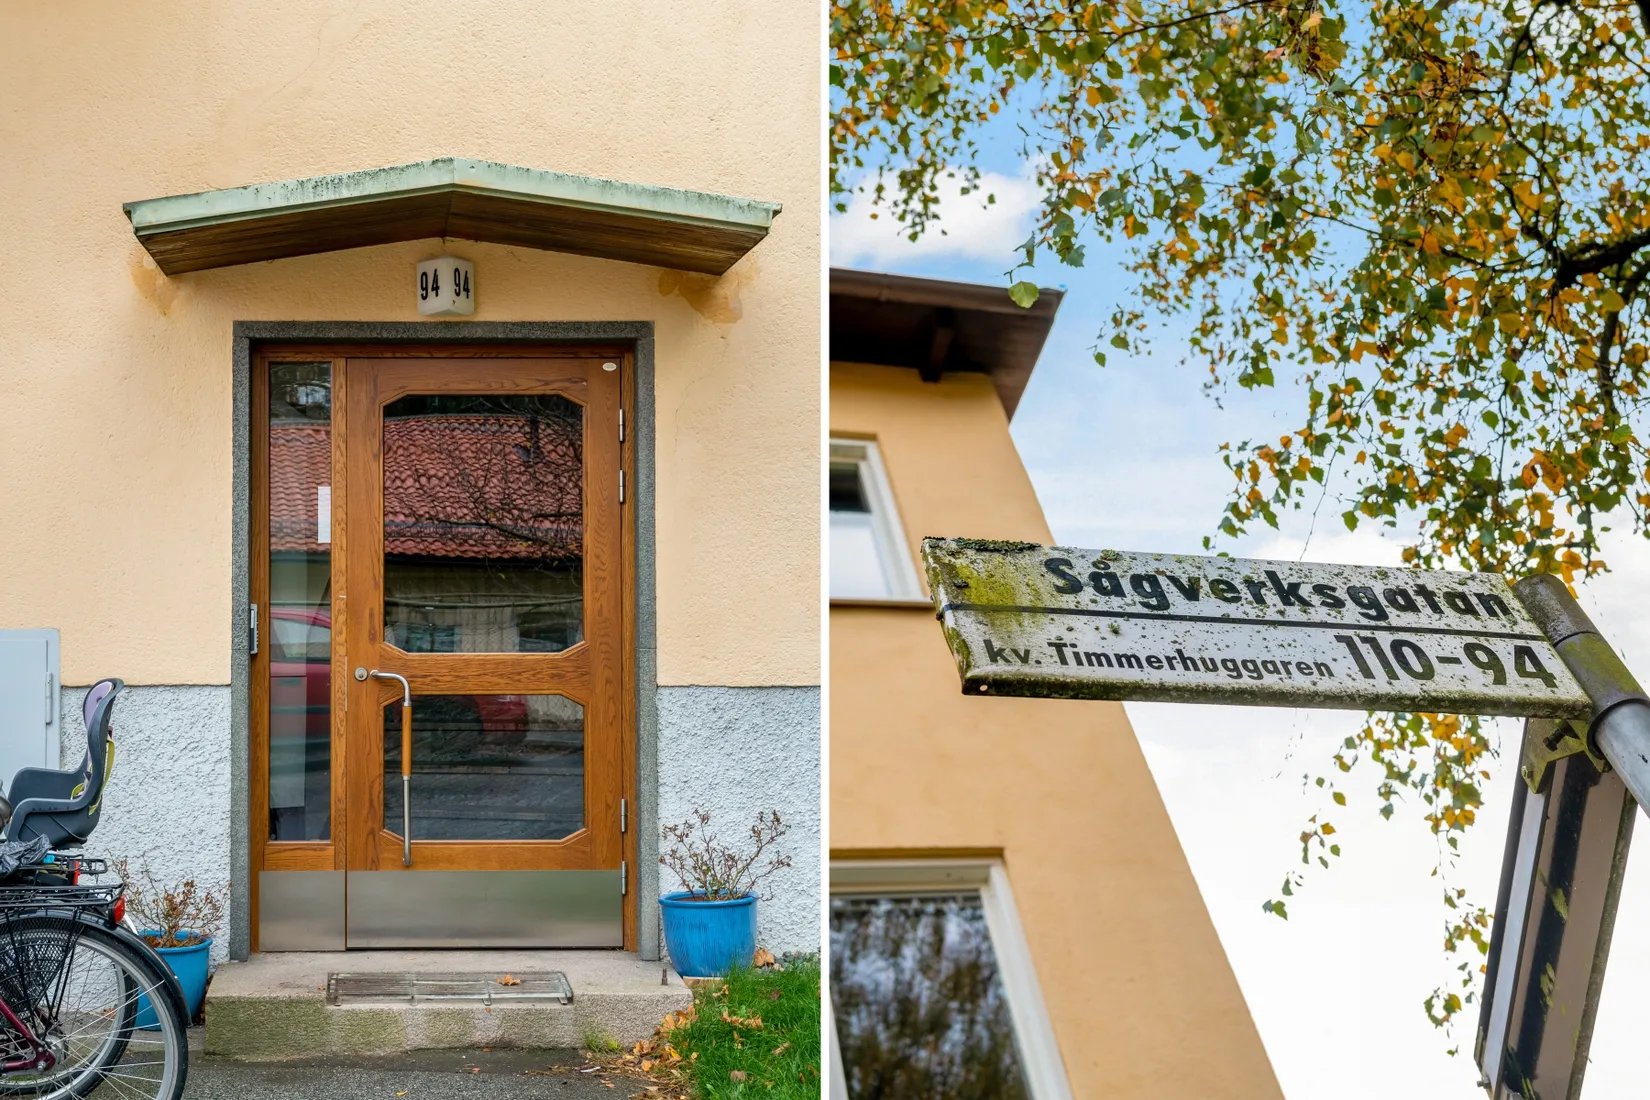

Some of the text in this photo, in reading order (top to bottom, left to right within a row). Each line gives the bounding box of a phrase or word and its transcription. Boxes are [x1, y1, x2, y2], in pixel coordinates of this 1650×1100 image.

[420, 268, 440, 301] 94
[454, 267, 470, 299] 94
[1043, 557, 1515, 622] Sågverksgatan
[982, 634, 1559, 689] kv. Timmerhuggaren 110-94
